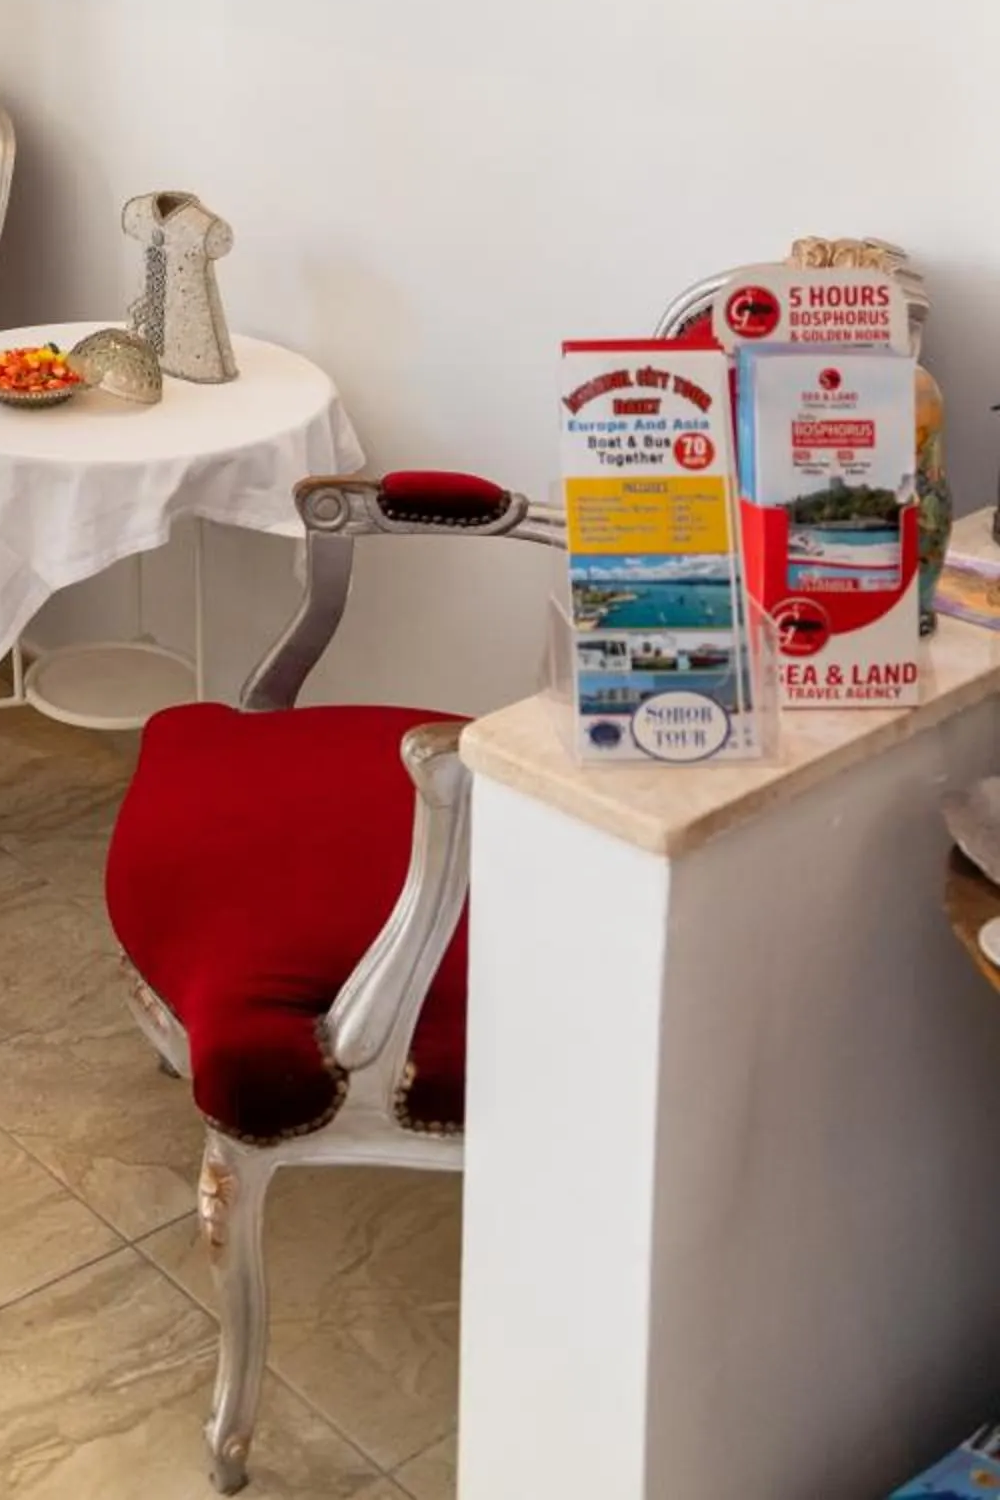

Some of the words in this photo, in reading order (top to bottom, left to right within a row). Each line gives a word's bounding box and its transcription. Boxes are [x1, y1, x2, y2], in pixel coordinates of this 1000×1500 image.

[789, 286, 801, 307] 5
[809, 285, 889, 307] HOURS
[789, 310, 889, 326] BOSPHORUS
[800, 329, 851, 341] GOLDEN
[855, 329, 889, 341] HORN
[567, 420, 628, 433] Europe
[634, 418, 666, 431] And
[672, 418, 710, 431] Asia
[587, 435, 622, 449] Boat
[627, 436, 637, 448] &
[643, 435, 672, 448] Bus
[681, 436, 707, 456] 70
[597, 451, 665, 467] Together
[779, 664, 817, 685] EA
[826, 663, 843, 686] &
[852, 662, 918, 685] LAND
[788, 687, 841, 699] TRAVEL
[846, 687, 902, 699] AGENCY
